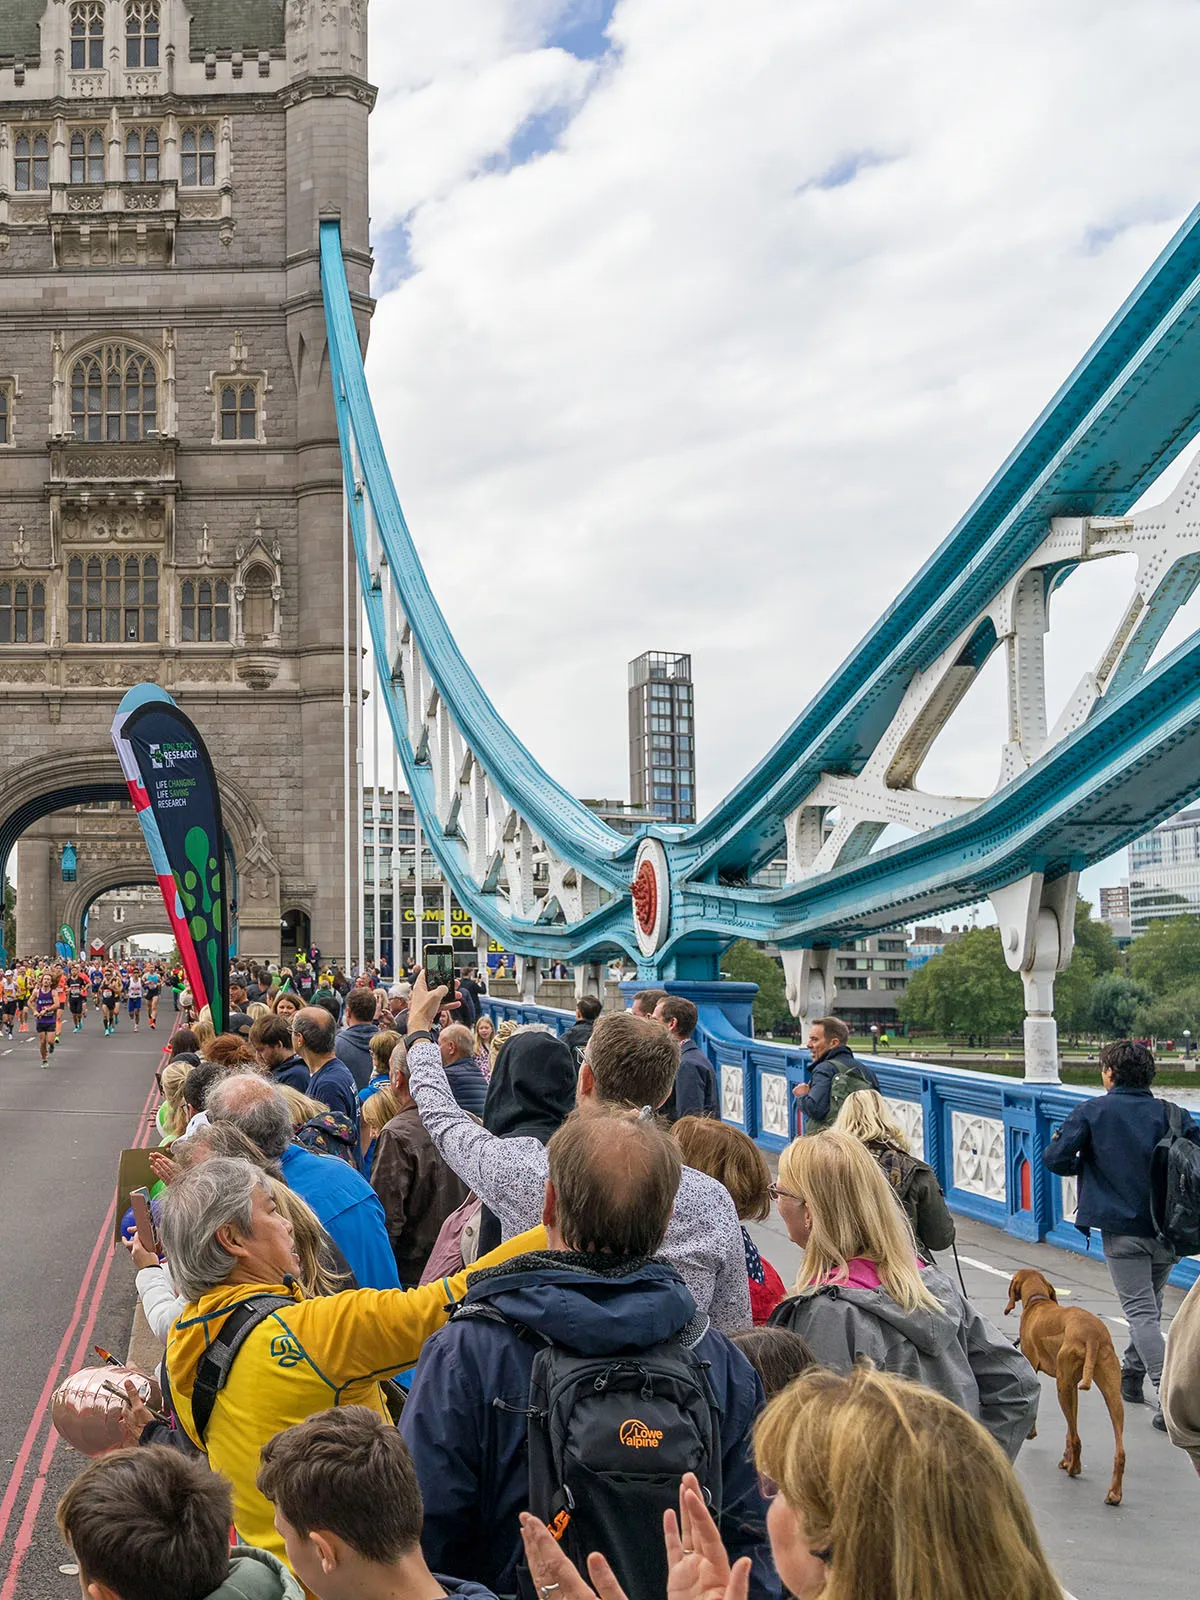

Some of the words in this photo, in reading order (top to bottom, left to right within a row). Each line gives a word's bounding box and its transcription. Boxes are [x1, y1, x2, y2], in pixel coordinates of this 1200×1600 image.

[164, 750, 197, 759] RESEARCH
[156, 781, 168, 789] LIFE
[168, 779, 196, 788] CHANGING
[157, 791, 169, 799] LIFE
[158, 798, 187, 808] RESEARCH
[634, 1427, 663, 1440] Lowe
[626, 1436, 659, 1449] alpine
